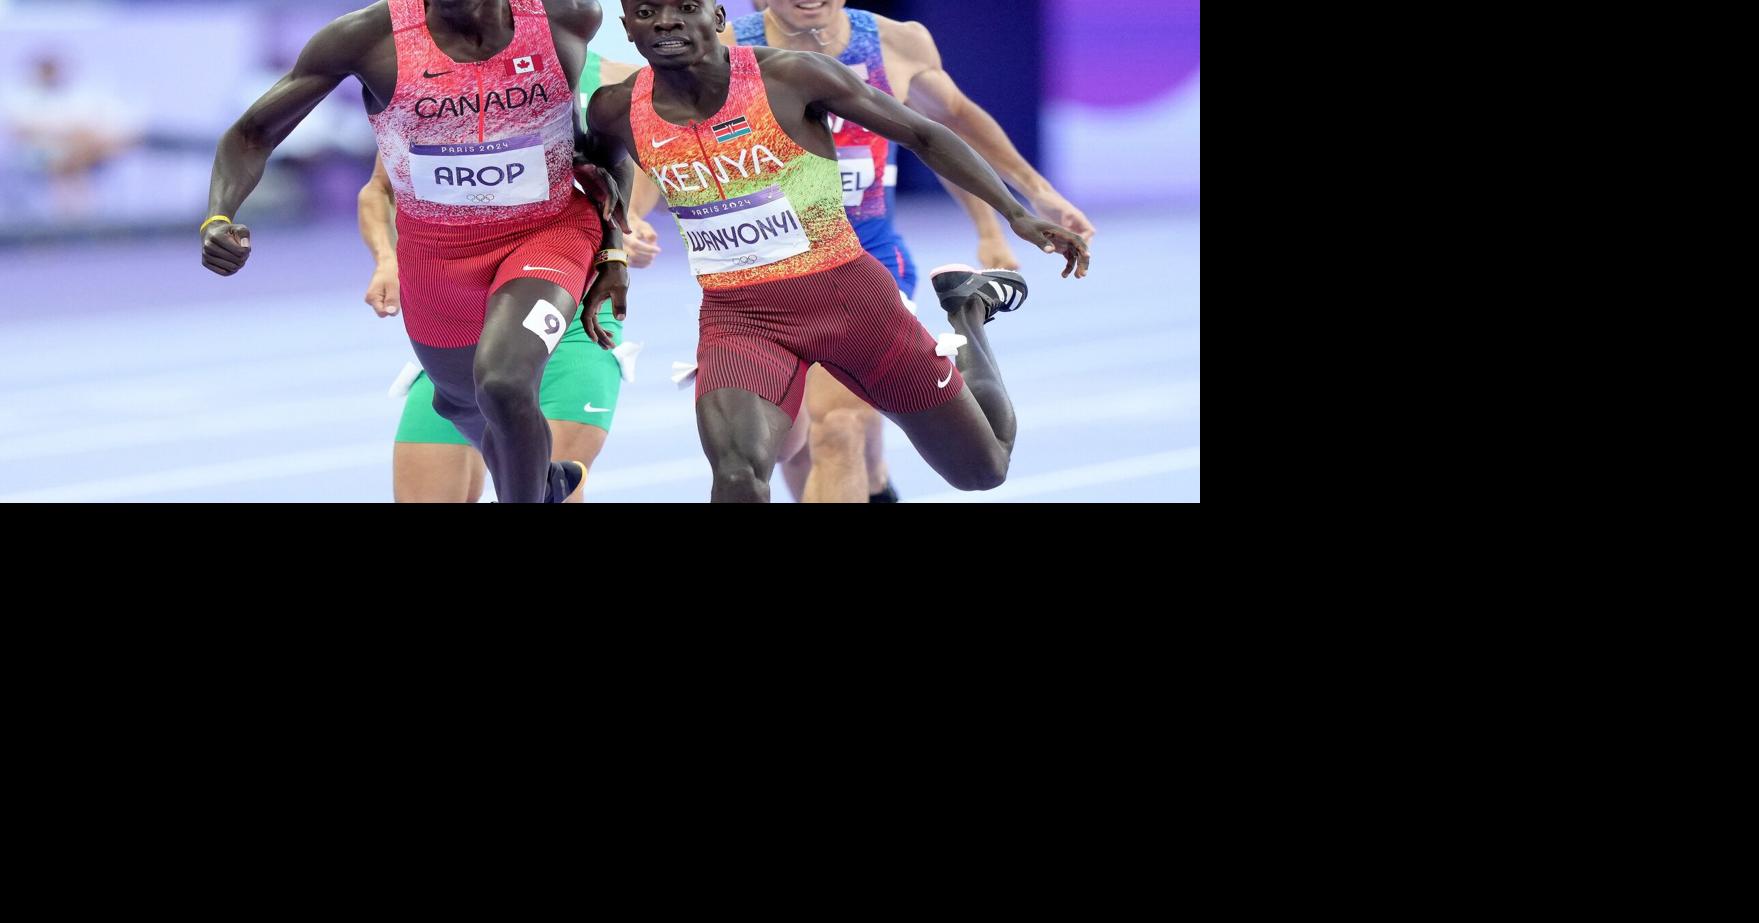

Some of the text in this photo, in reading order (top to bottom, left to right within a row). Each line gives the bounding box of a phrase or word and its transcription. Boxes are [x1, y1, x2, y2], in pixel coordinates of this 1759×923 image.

[414, 83, 548, 118] CANADA
[479, 142, 508, 152] 2024
[434, 162, 525, 187] AROP
[651, 144, 785, 193] KENYA
[691, 199, 751, 216] PARIS 2024
[686, 209, 798, 252] WANYONYI
[544, 313, 560, 335] 9
